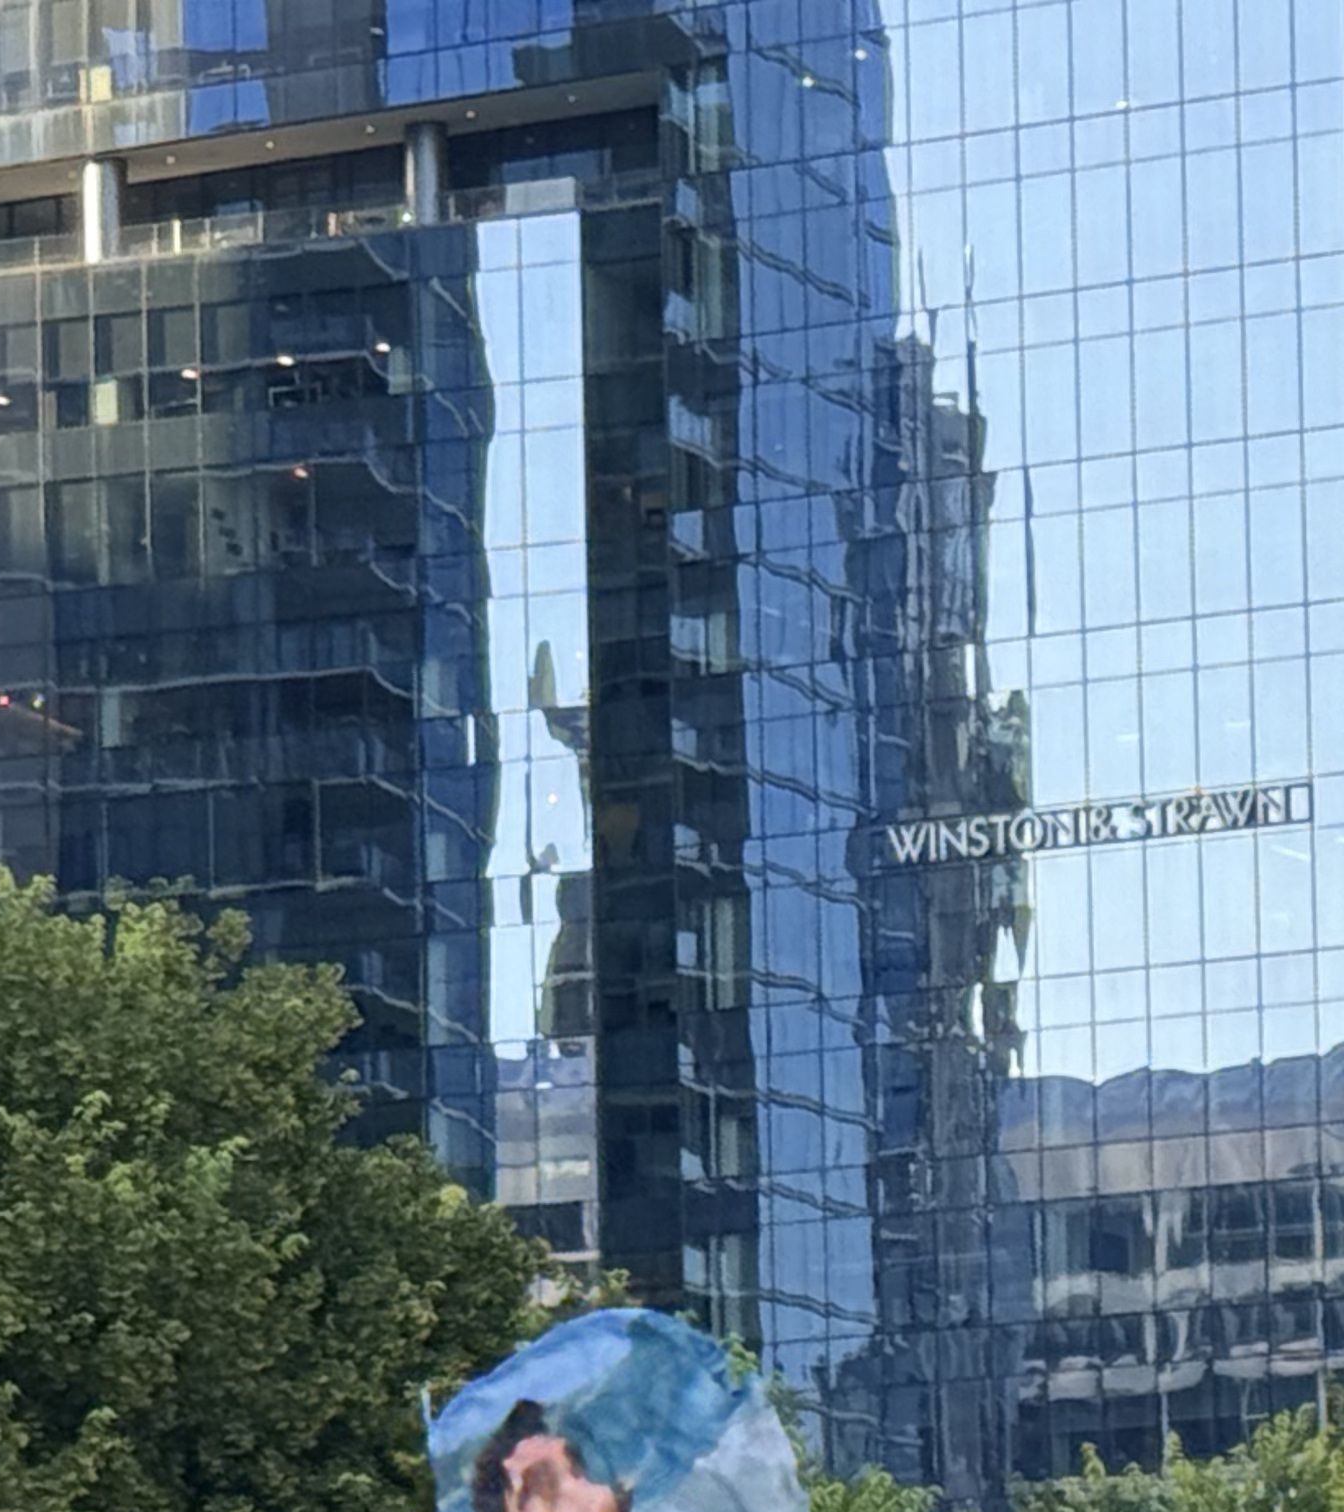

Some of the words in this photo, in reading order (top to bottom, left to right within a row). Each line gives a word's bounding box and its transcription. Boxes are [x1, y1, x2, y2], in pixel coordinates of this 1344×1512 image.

[886, 809, 1075, 864] WINSTON
[1088, 805, 1118, 841] &
[1129, 785, 1287, 837] STRAWN
